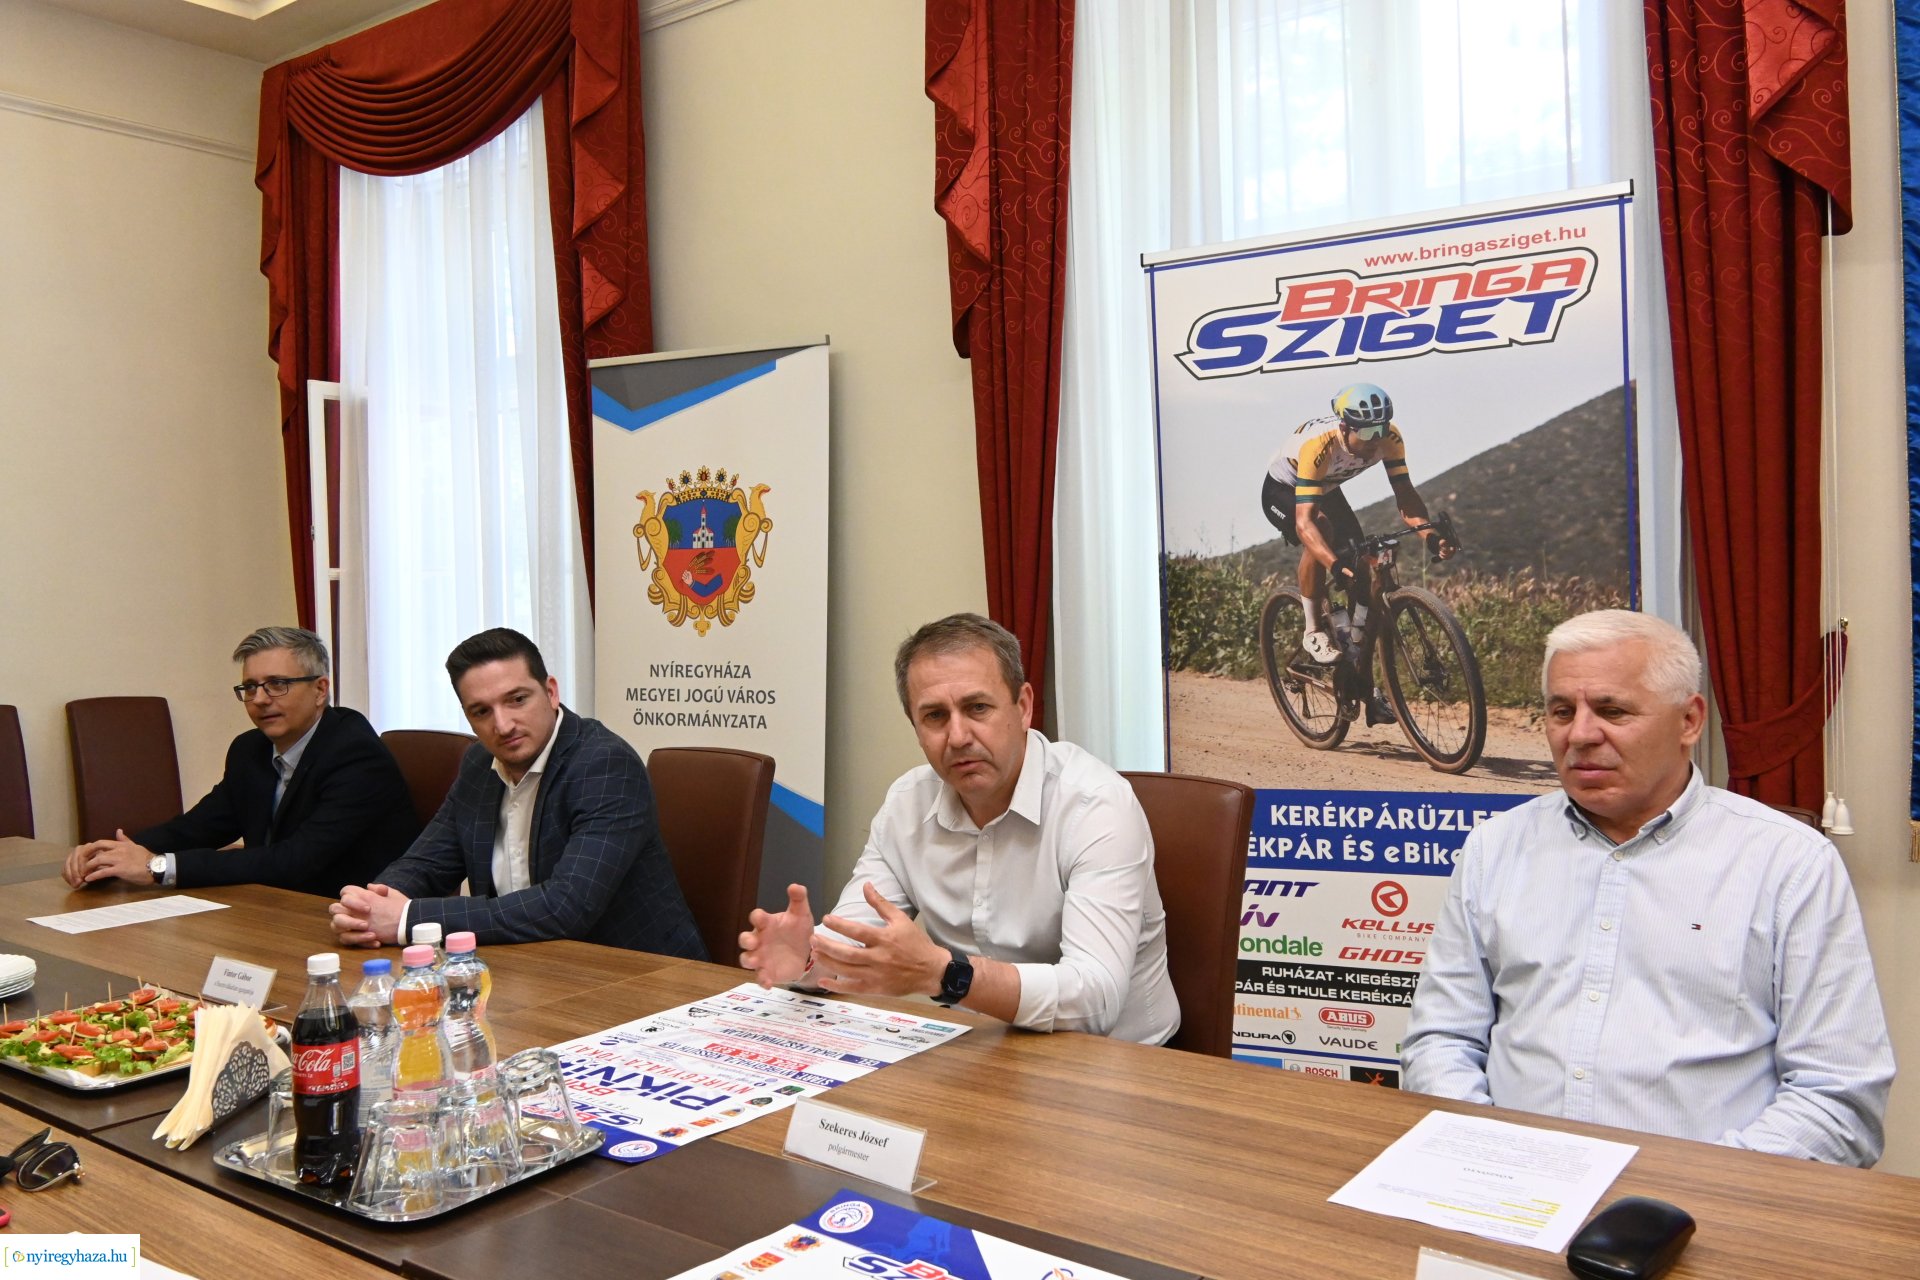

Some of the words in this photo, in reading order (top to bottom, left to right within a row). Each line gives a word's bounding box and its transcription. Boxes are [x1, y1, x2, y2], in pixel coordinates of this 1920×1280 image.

[1364, 225, 1587, 268] www.bringasziget.hu
[1281, 256, 1587, 322] BRINGA
[1193, 288, 1578, 371] SZIGET
[650, 661, 752, 679] NYÍREGYHÁZA
[626, 687, 680, 702] MEGYEI
[684, 685, 724, 703] JOGÚ
[727, 686, 776, 704] VÁROS
[633, 708, 767, 729] ÖNKORMÁNYZATA
[1343, 834, 1375, 862] ÉS
[1356, 932, 1378, 940] BIKE
[1382, 934, 1427, 943] COMPANY
[1262, 965, 1335, 982] RUHÁZAT
[1345, 973, 1419, 989] KIEGÉSZÍ
[1266, 980, 1286, 994] ÉS
[1288, 985, 1338, 998] THULE
[1326, 1011, 1368, 1025] ABUS
[1319, 1035, 1379, 1051] VAUDE
[819, 1118, 857, 1139] Szekeres
[858, 1129, 890, 1148] József
[827, 1143, 870, 1162] polgármester
